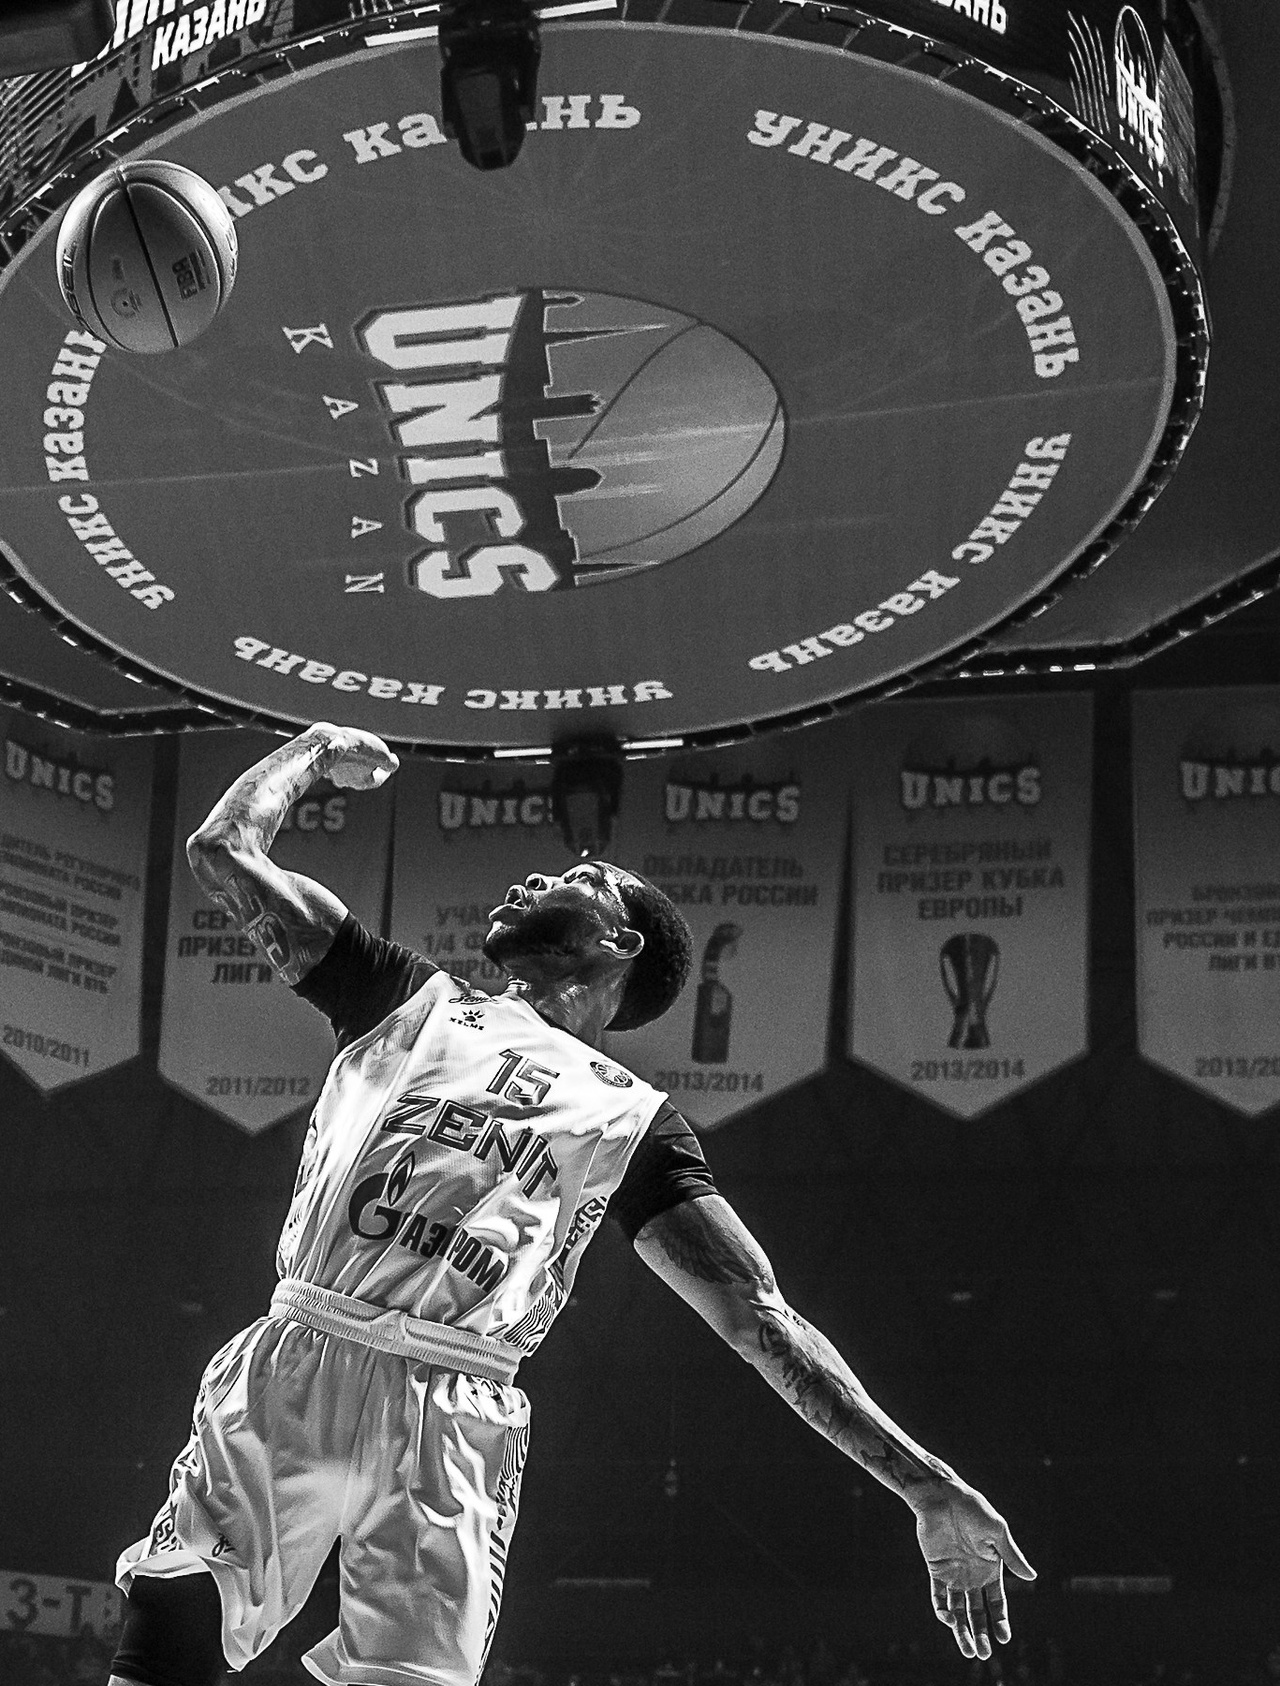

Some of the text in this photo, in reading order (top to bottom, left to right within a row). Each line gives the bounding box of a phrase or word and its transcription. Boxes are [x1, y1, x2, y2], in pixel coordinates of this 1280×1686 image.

[360, 292, 560, 601] UNICS
[5, 739, 115, 810] UNICS
[900, 766, 1042, 810] UNICS
[439, 790, 554, 830] UNIC
[665, 782, 801, 823] UNICS
[883, 838, 1052, 866] СЕРЕБРЯНЫЙ
[721, 884, 819, 907] РОССИИ
[877, 865, 1065, 893] ПРИЗЕР КУБКА
[918, 896, 1023, 920] ЕВРОПЫ
[2, 1024, 90, 1068] 2010/2011
[207, 1077, 310, 1097] 2011/2012
[485, 1048, 560, 1106] 15
[910, 1057, 1027, 1081] 2013/2014
[381, 1093, 558, 1199] ZENIT
